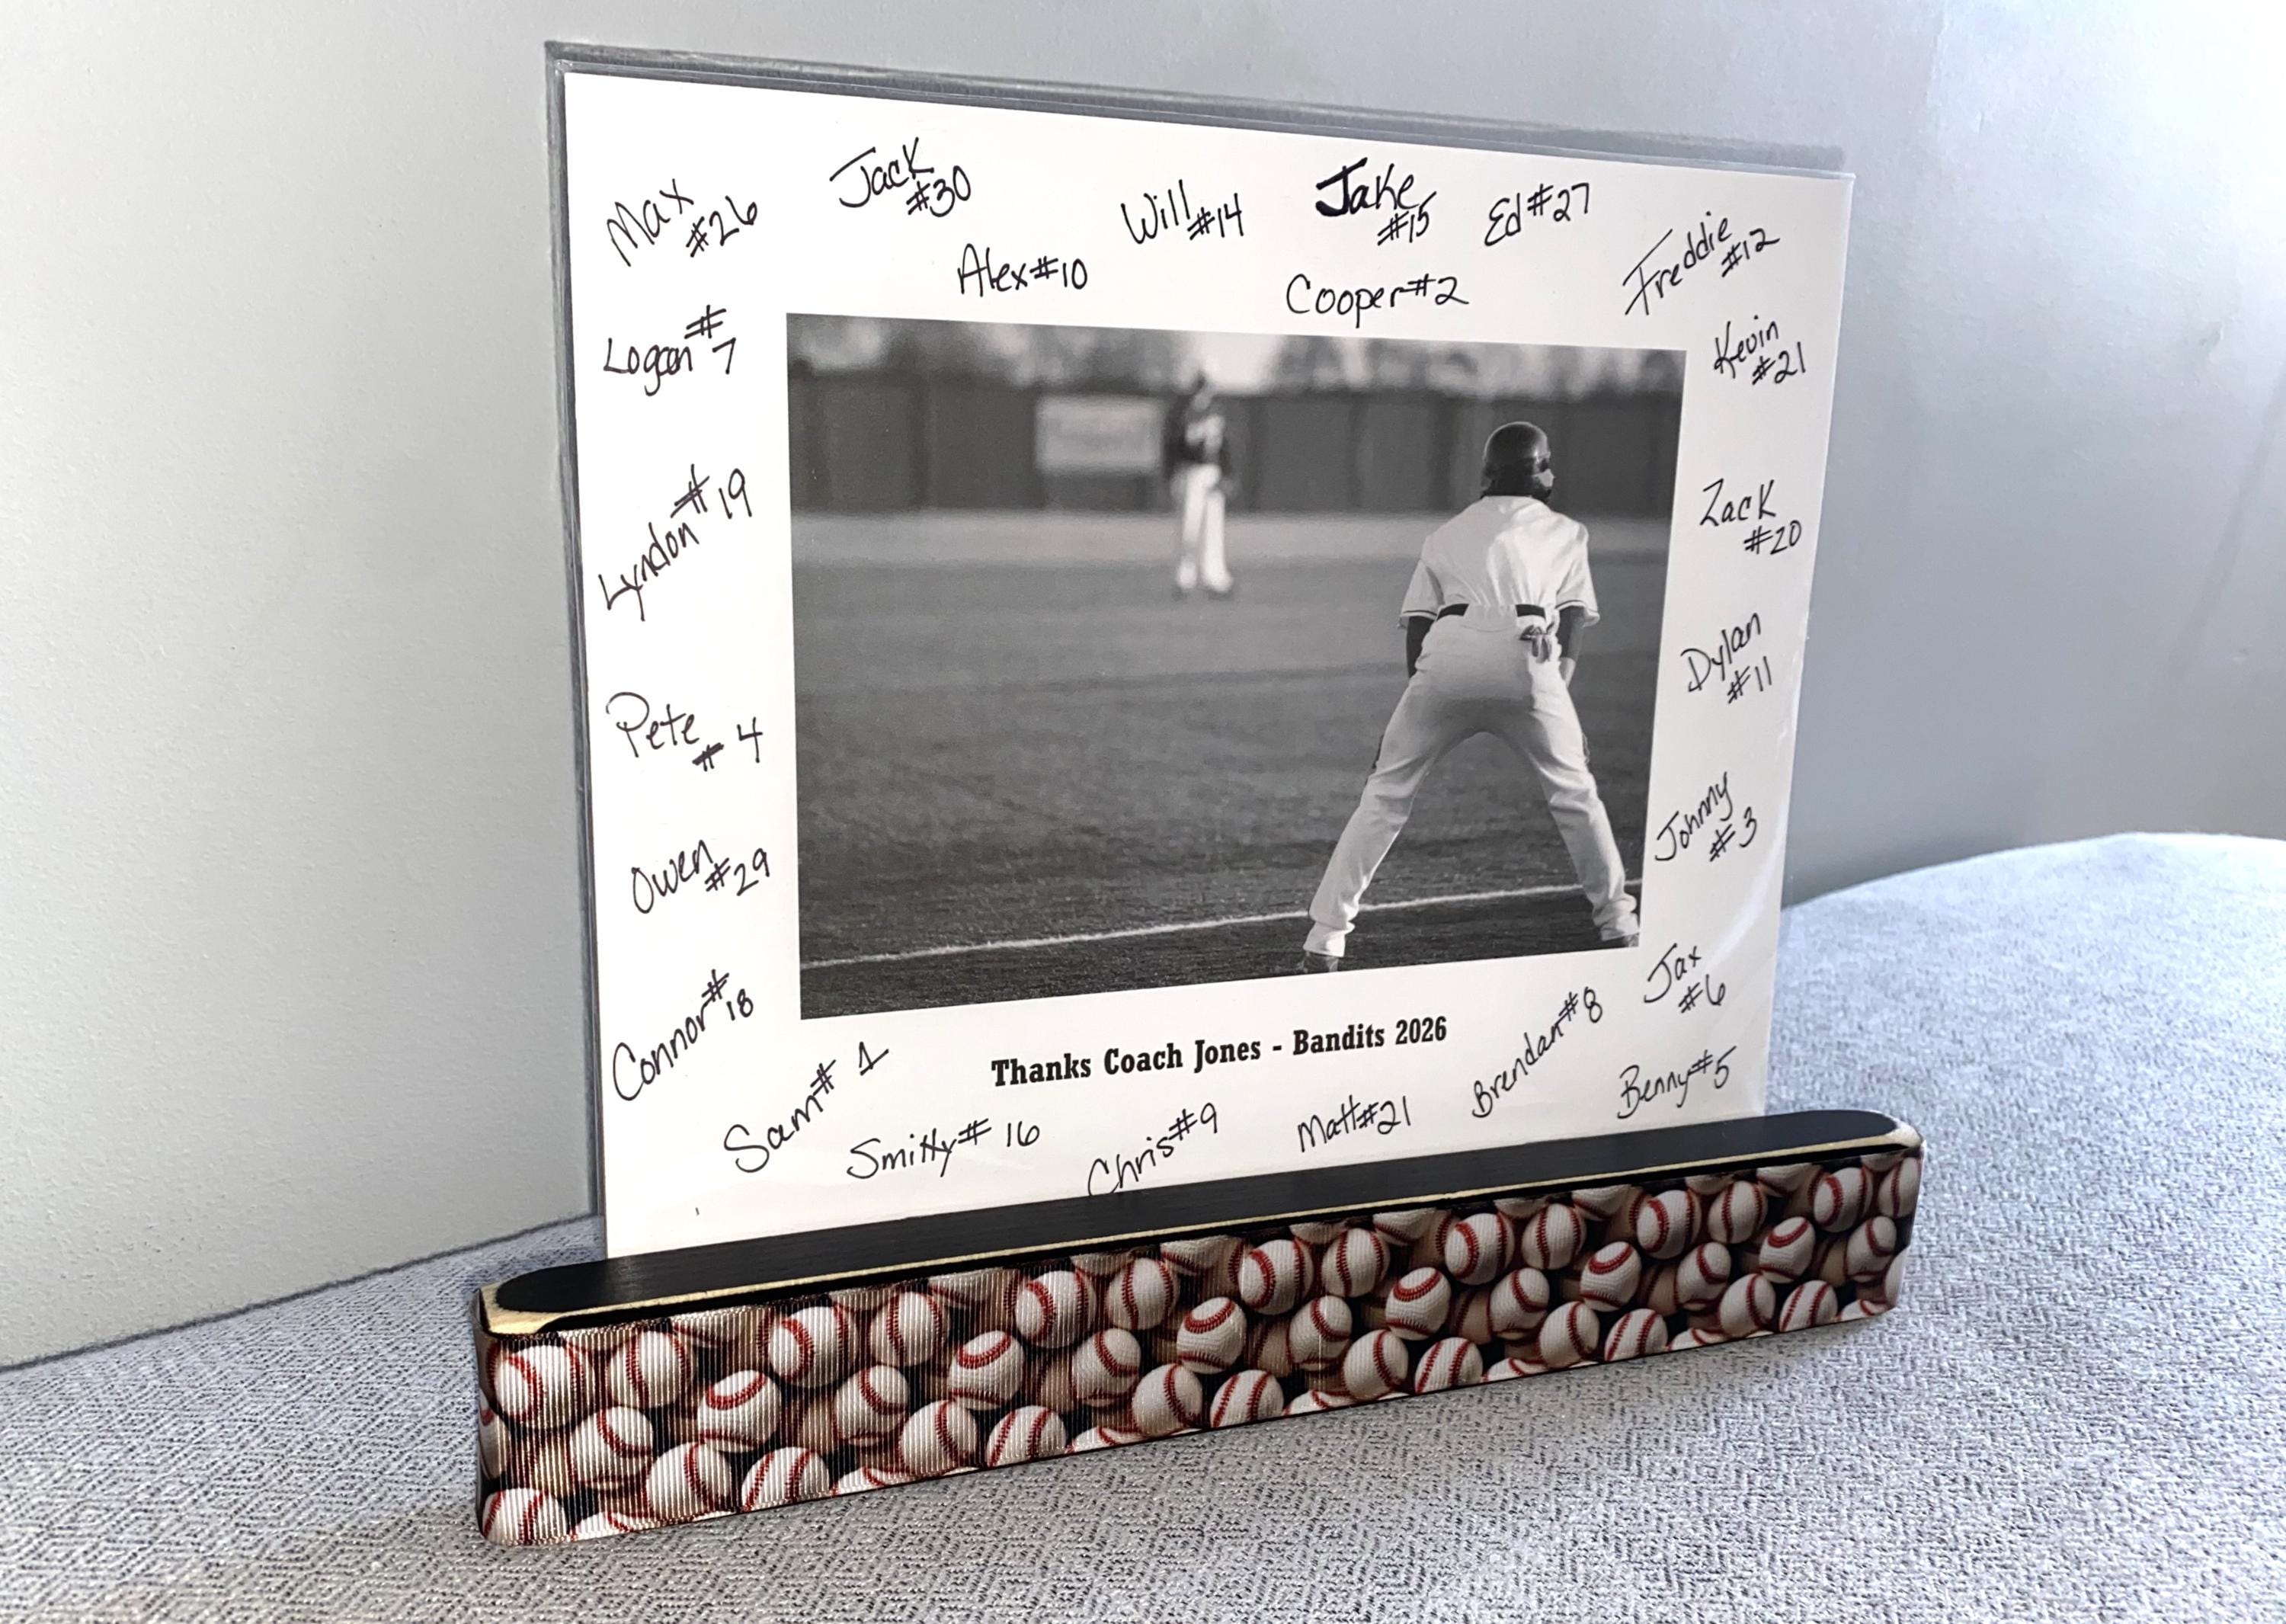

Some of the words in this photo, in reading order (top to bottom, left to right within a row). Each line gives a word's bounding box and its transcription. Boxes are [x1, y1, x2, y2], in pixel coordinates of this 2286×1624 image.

[830, 137, 935, 208] Jack
[1315, 157, 1420, 217] Jake
[607, 178, 694, 267] Max
[1622, 211, 1732, 316] Freddie
[1714, 315, 1779, 380] Kevin
[1700, 478, 1776, 527] Zack
[1680, 613, 1761, 692] Dylan
[606, 692, 700, 758] Pete
[1654, 771, 1733, 861] Johnny
[632, 840, 713, 914] Owen
[1644, 943, 1702, 1003] Jax
[991, 1052, 1091, 1087] Thanks
[1103, 1043, 1183, 1075] Coach
[1194, 1039, 1261, 1073] Jones
[1292, 1023, 1385, 1055] Bandits
[1395, 1016, 1447, 1045] 2026
